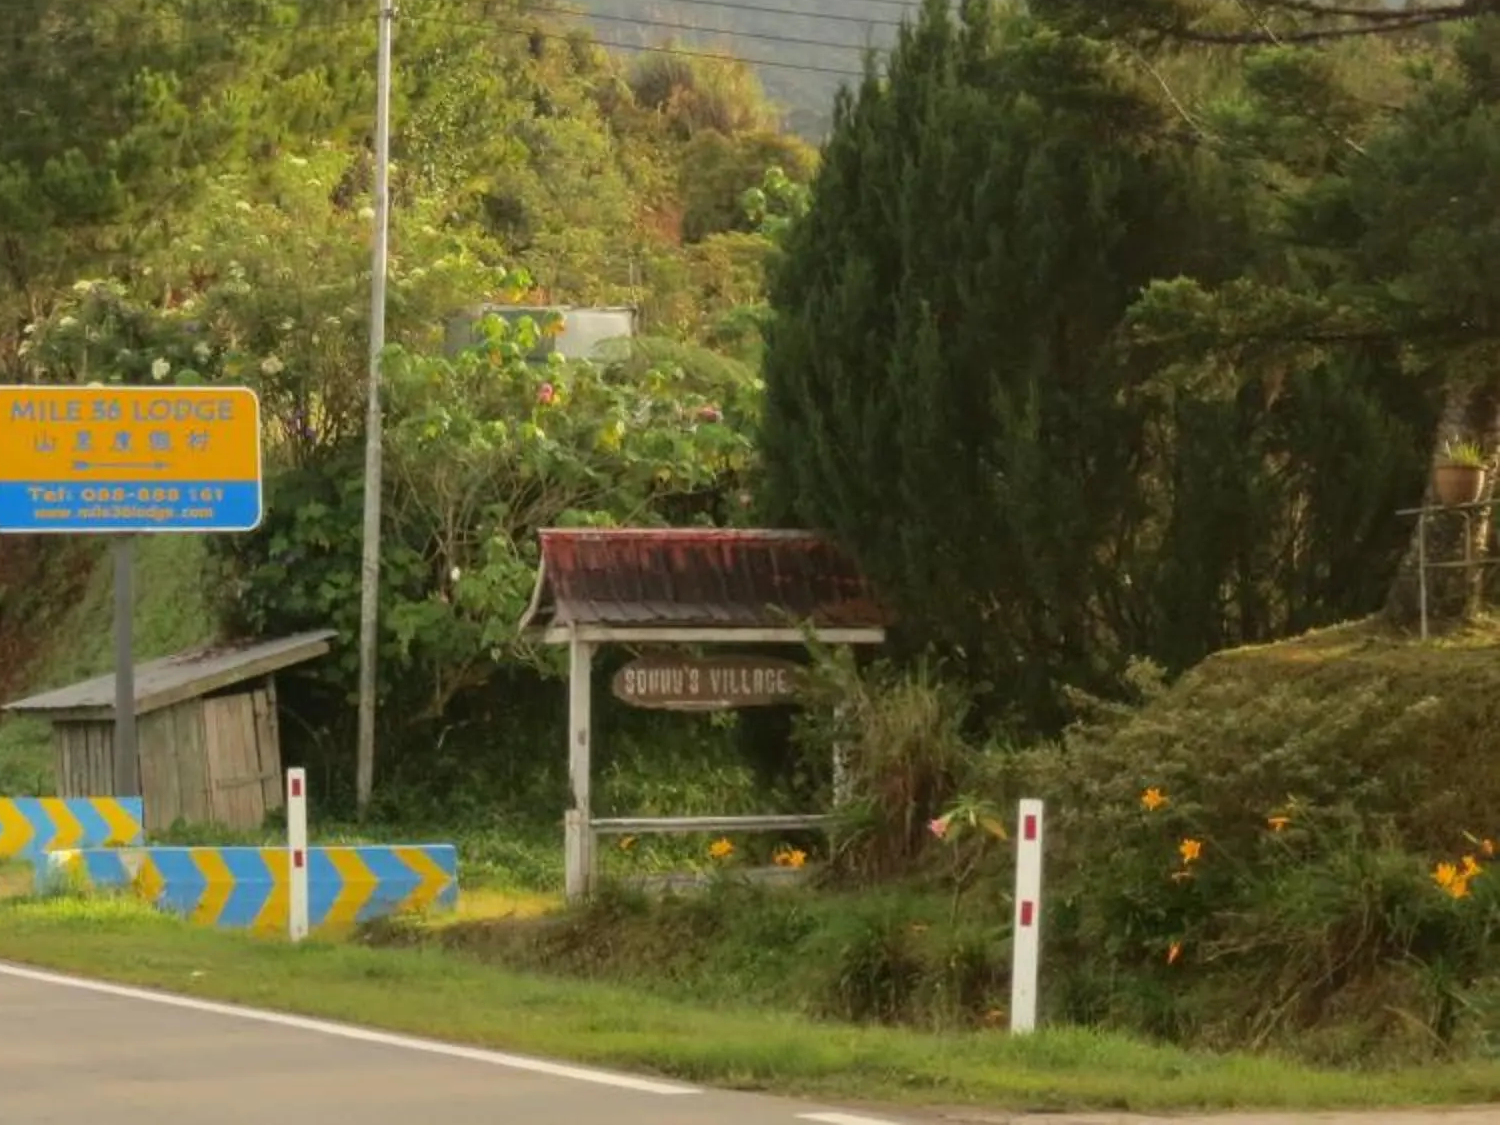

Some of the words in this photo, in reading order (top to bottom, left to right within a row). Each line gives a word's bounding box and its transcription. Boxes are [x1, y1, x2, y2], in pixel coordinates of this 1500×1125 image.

[10, 399, 80, 422] MILE
[90, 398, 121, 422] 36
[132, 398, 235, 422] LODGE
[709, 667, 789, 695] VILLAGE
